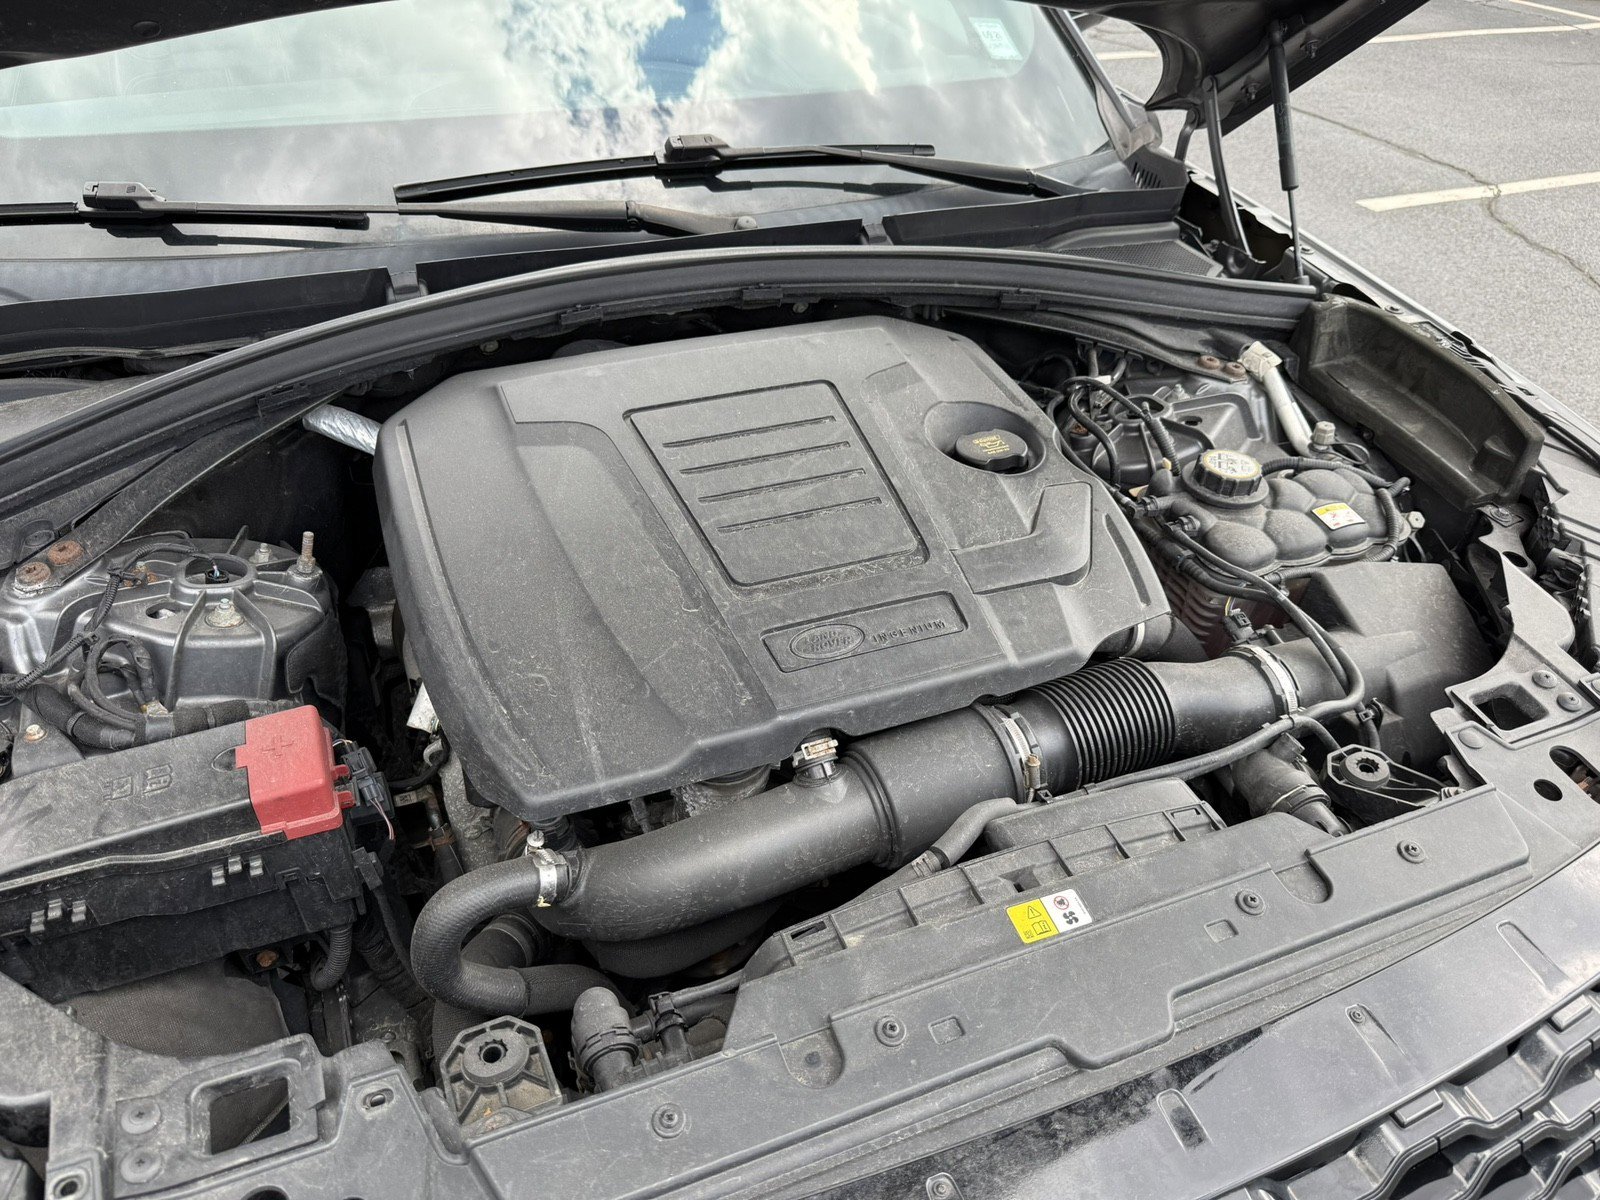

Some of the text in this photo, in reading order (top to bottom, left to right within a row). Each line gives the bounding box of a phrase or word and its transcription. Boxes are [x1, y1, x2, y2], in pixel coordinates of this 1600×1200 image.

[806, 630, 840, 643] LAND
[872, 620, 945, 643] INGENIUM
[809, 636, 851, 651] ROVER
